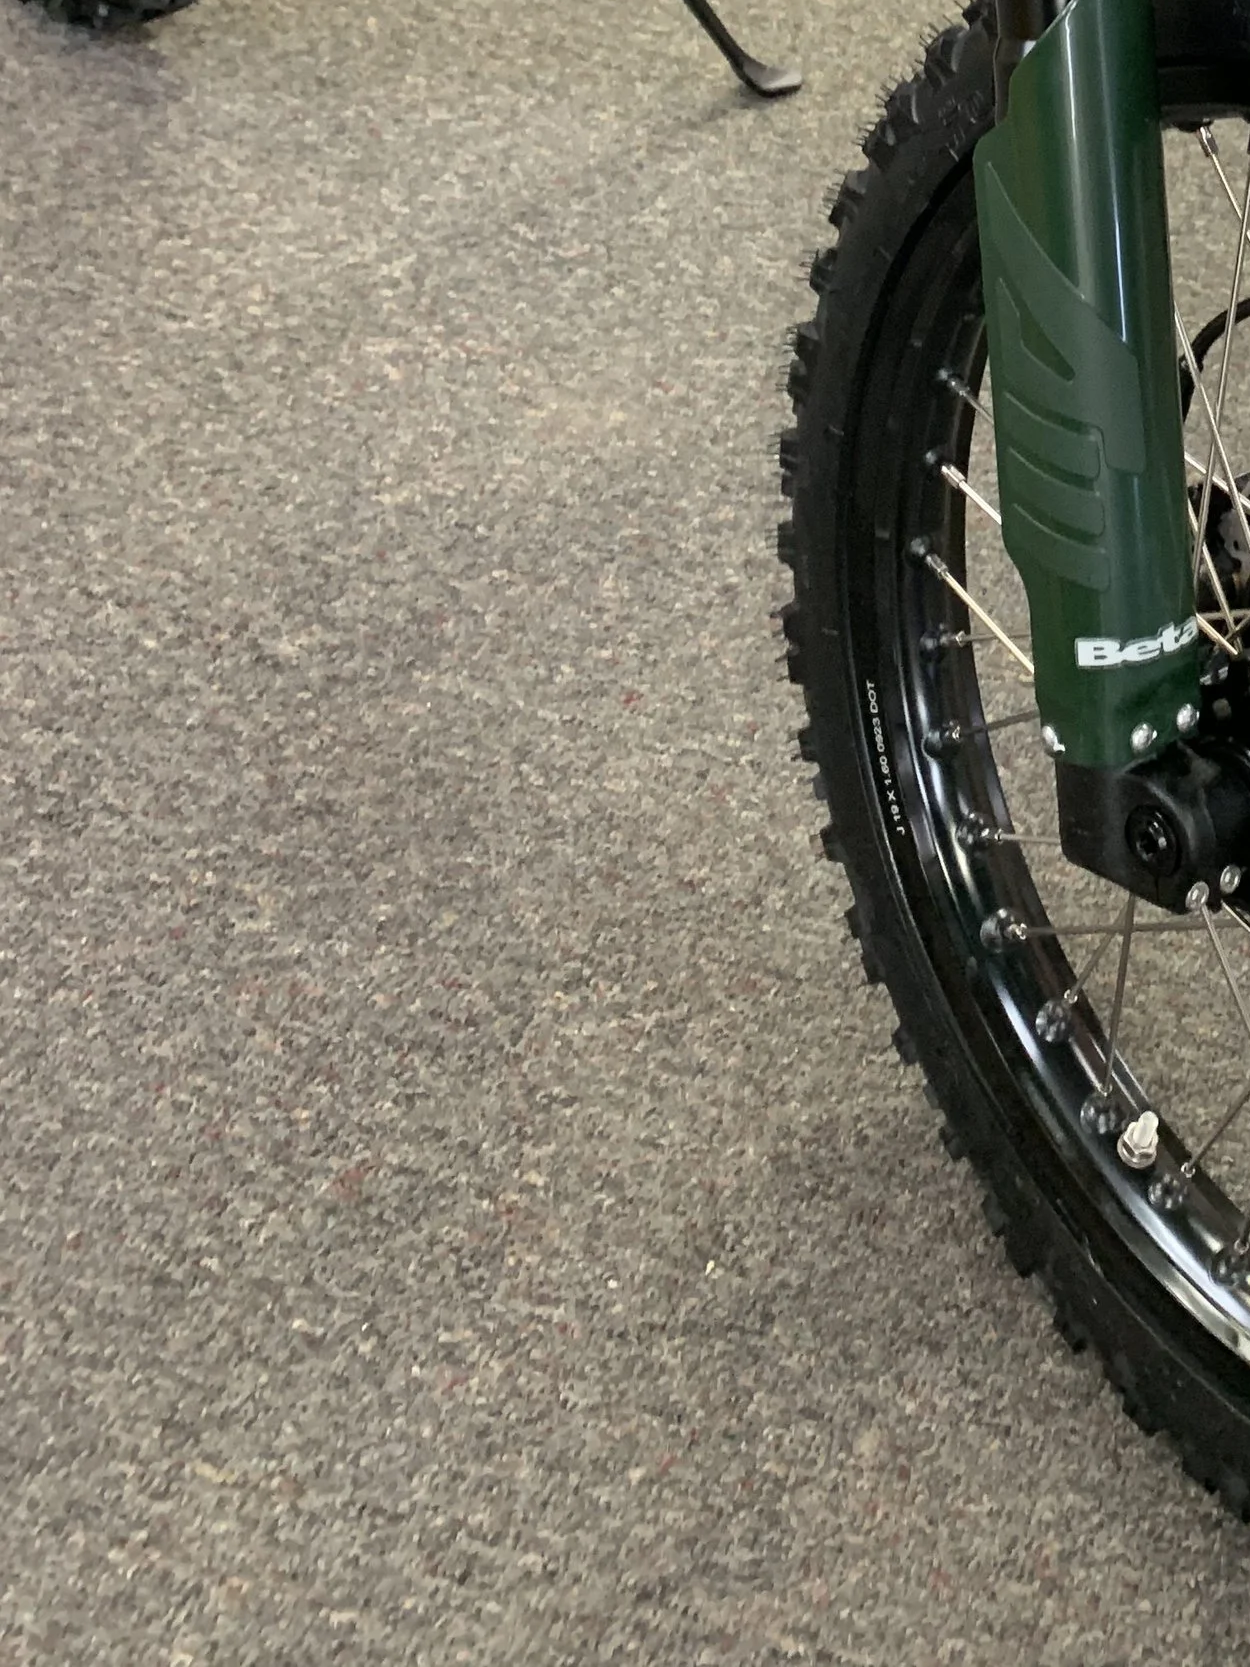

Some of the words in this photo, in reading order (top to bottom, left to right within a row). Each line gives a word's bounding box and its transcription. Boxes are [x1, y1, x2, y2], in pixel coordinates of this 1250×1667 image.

[1075, 616, 1199, 669] Beta
[866, 679, 878, 713] DOT
[872, 717, 885, 752] 0923
[880, 755, 892, 786] 1.60
[887, 789, 896, 802] X
[891, 804, 901, 822] 19
